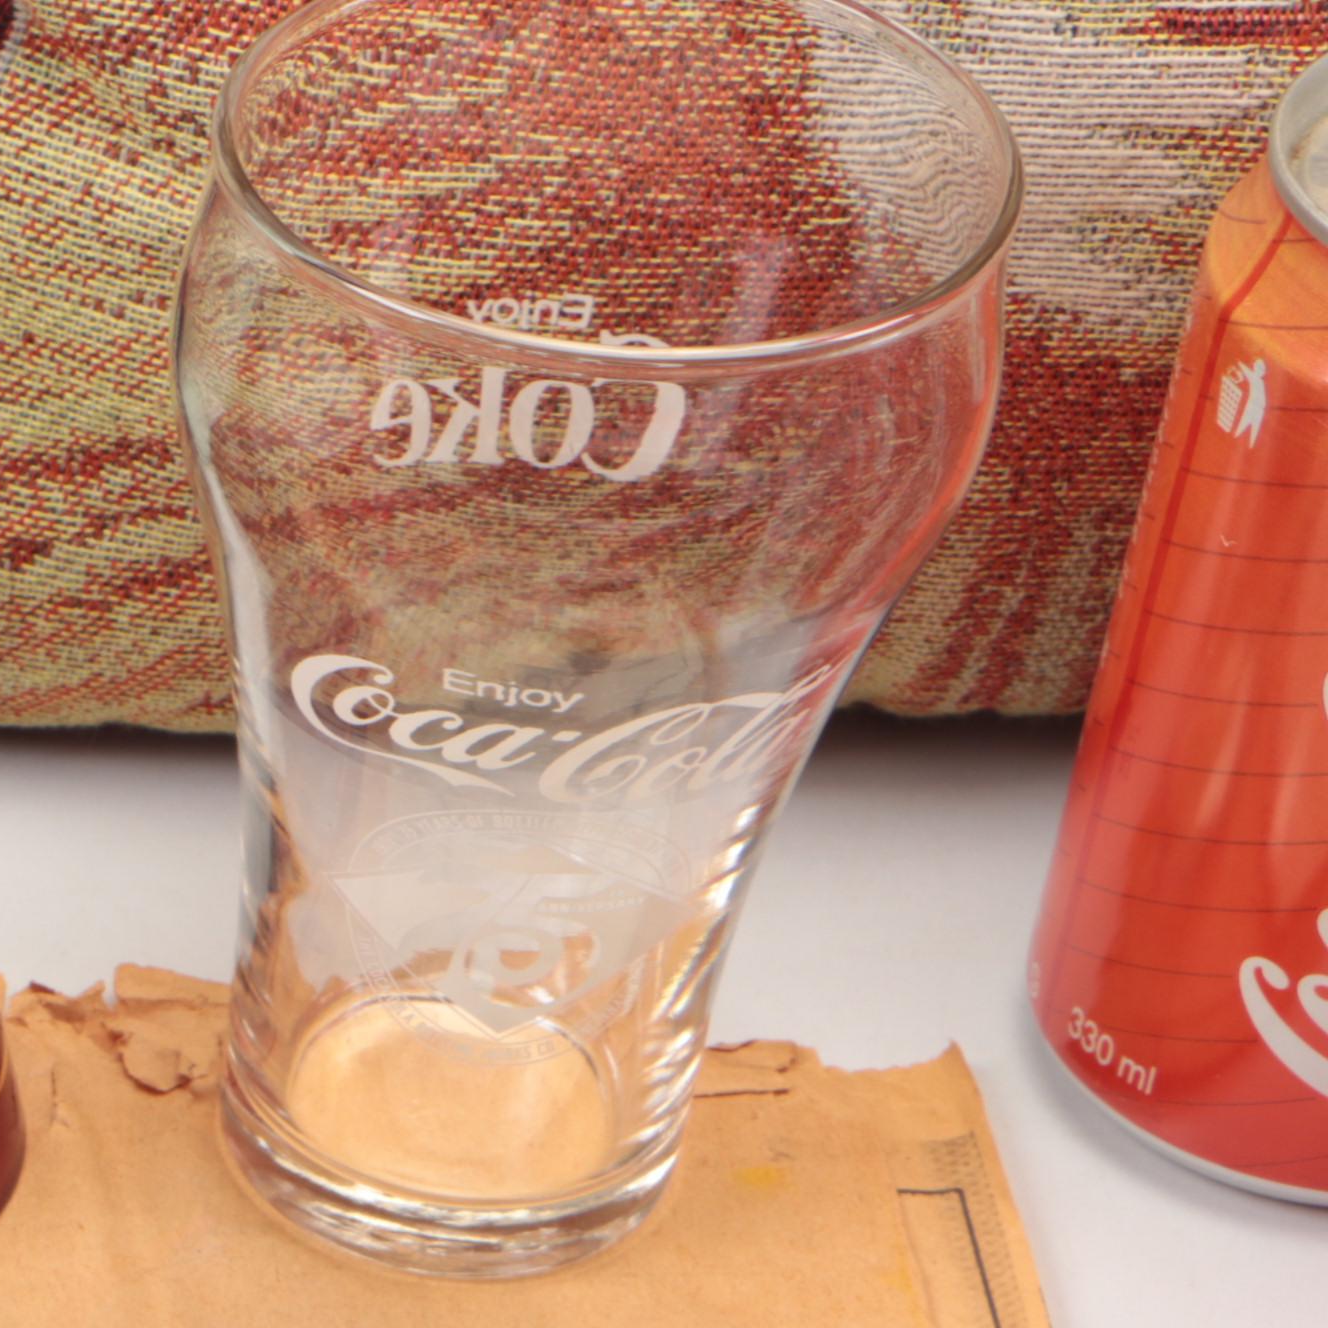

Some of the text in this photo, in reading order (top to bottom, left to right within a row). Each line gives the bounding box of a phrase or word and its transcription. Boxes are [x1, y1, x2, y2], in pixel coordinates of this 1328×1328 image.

[290, 654, 832, 803] Coca-Cola
[443, 667, 584, 711] Enjoy
[1068, 1006, 1157, 1096] 330 ml
